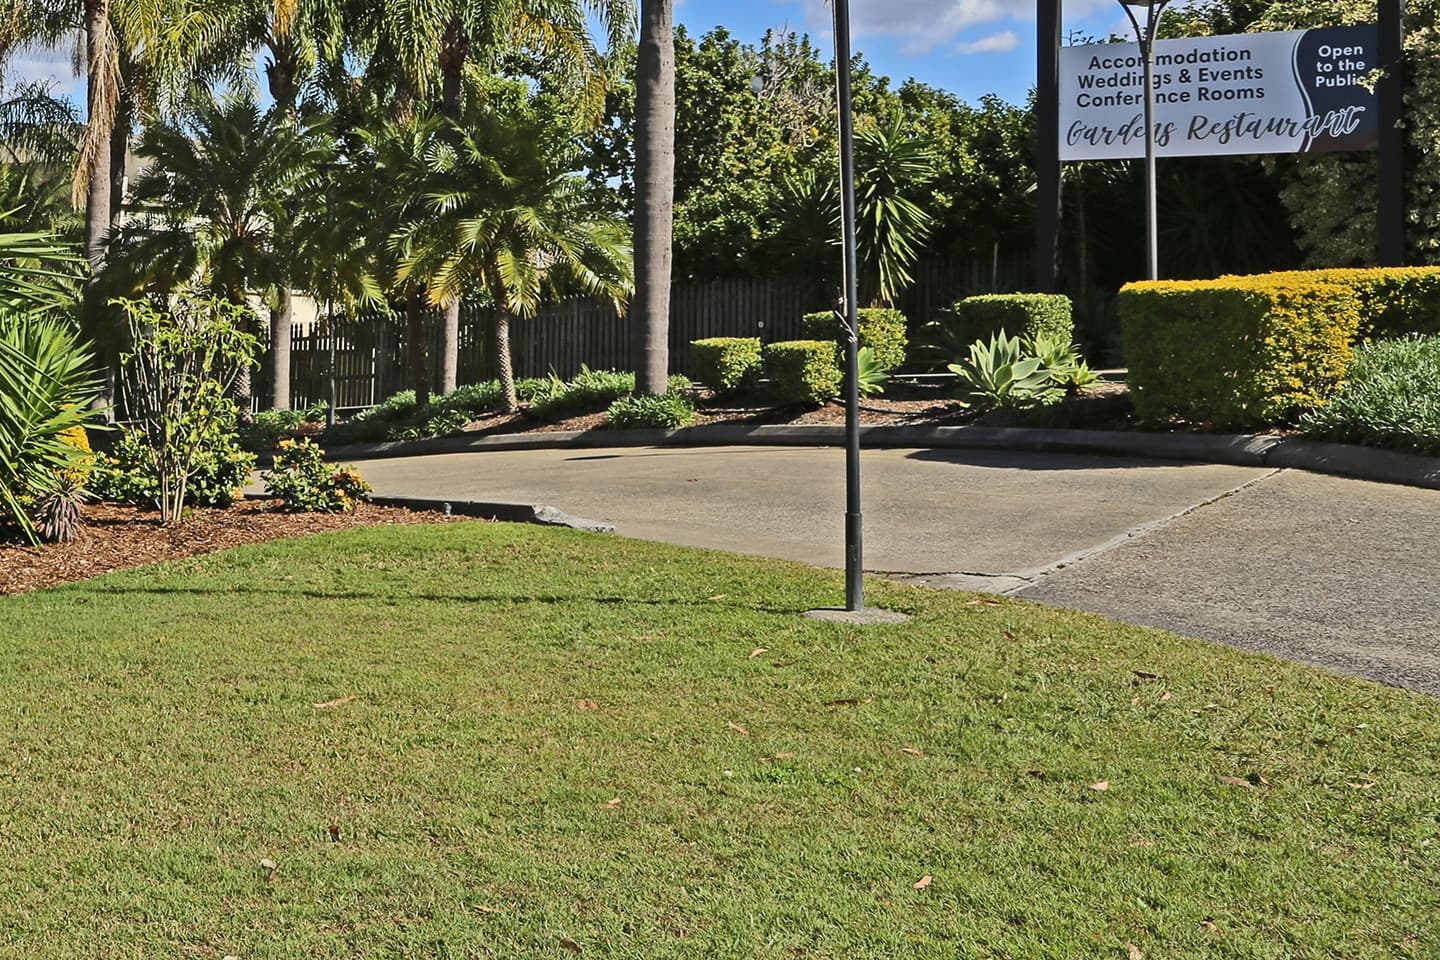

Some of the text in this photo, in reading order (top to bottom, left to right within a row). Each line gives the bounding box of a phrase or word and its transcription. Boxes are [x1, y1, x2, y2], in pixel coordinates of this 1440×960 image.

[1318, 44, 1364, 60] Open
[1178, 68, 1193, 84] &
[1198, 65, 1264, 83] Events
[1315, 58, 1366, 73] to the
[1076, 86, 1266, 109] Confernce Rooms
[1187, 105, 1366, 145] Restaurant
